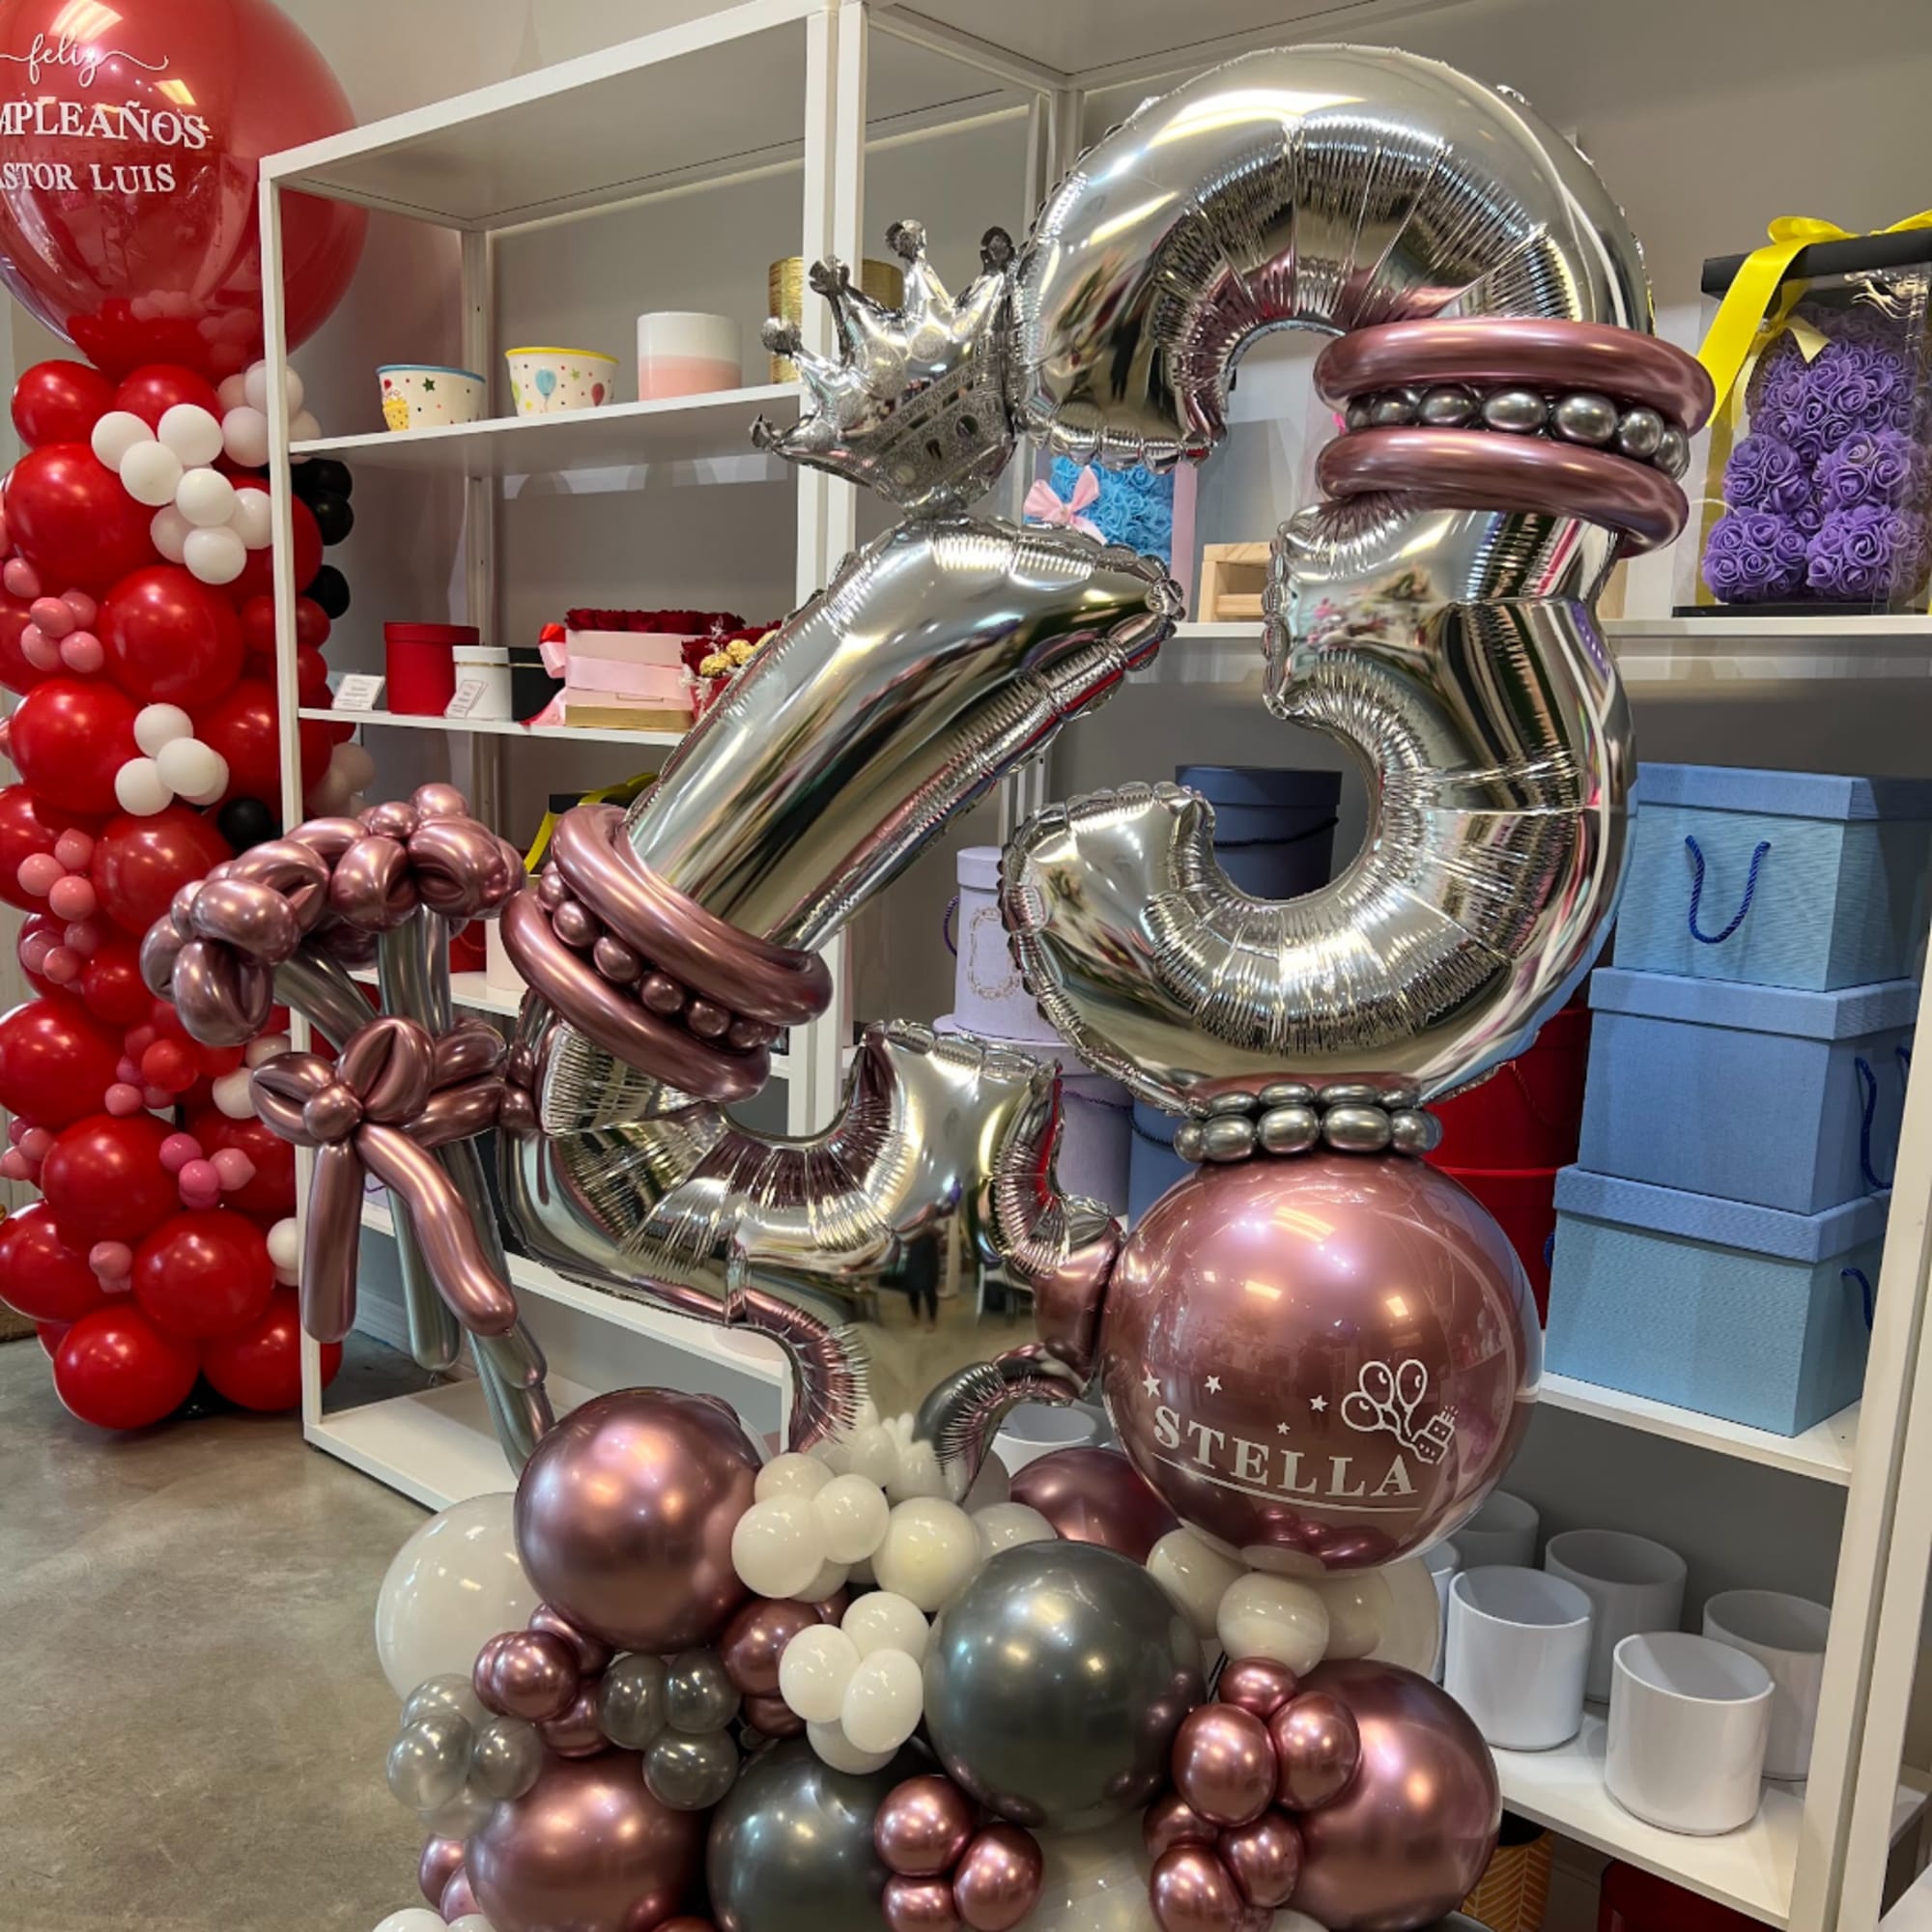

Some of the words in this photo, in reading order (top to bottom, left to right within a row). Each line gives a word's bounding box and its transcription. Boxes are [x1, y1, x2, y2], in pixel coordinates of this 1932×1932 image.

[0, 161, 79, 191] STOR
[90, 163, 177, 193] LUIS
[1152, 1405, 1418, 1498] STELLA
